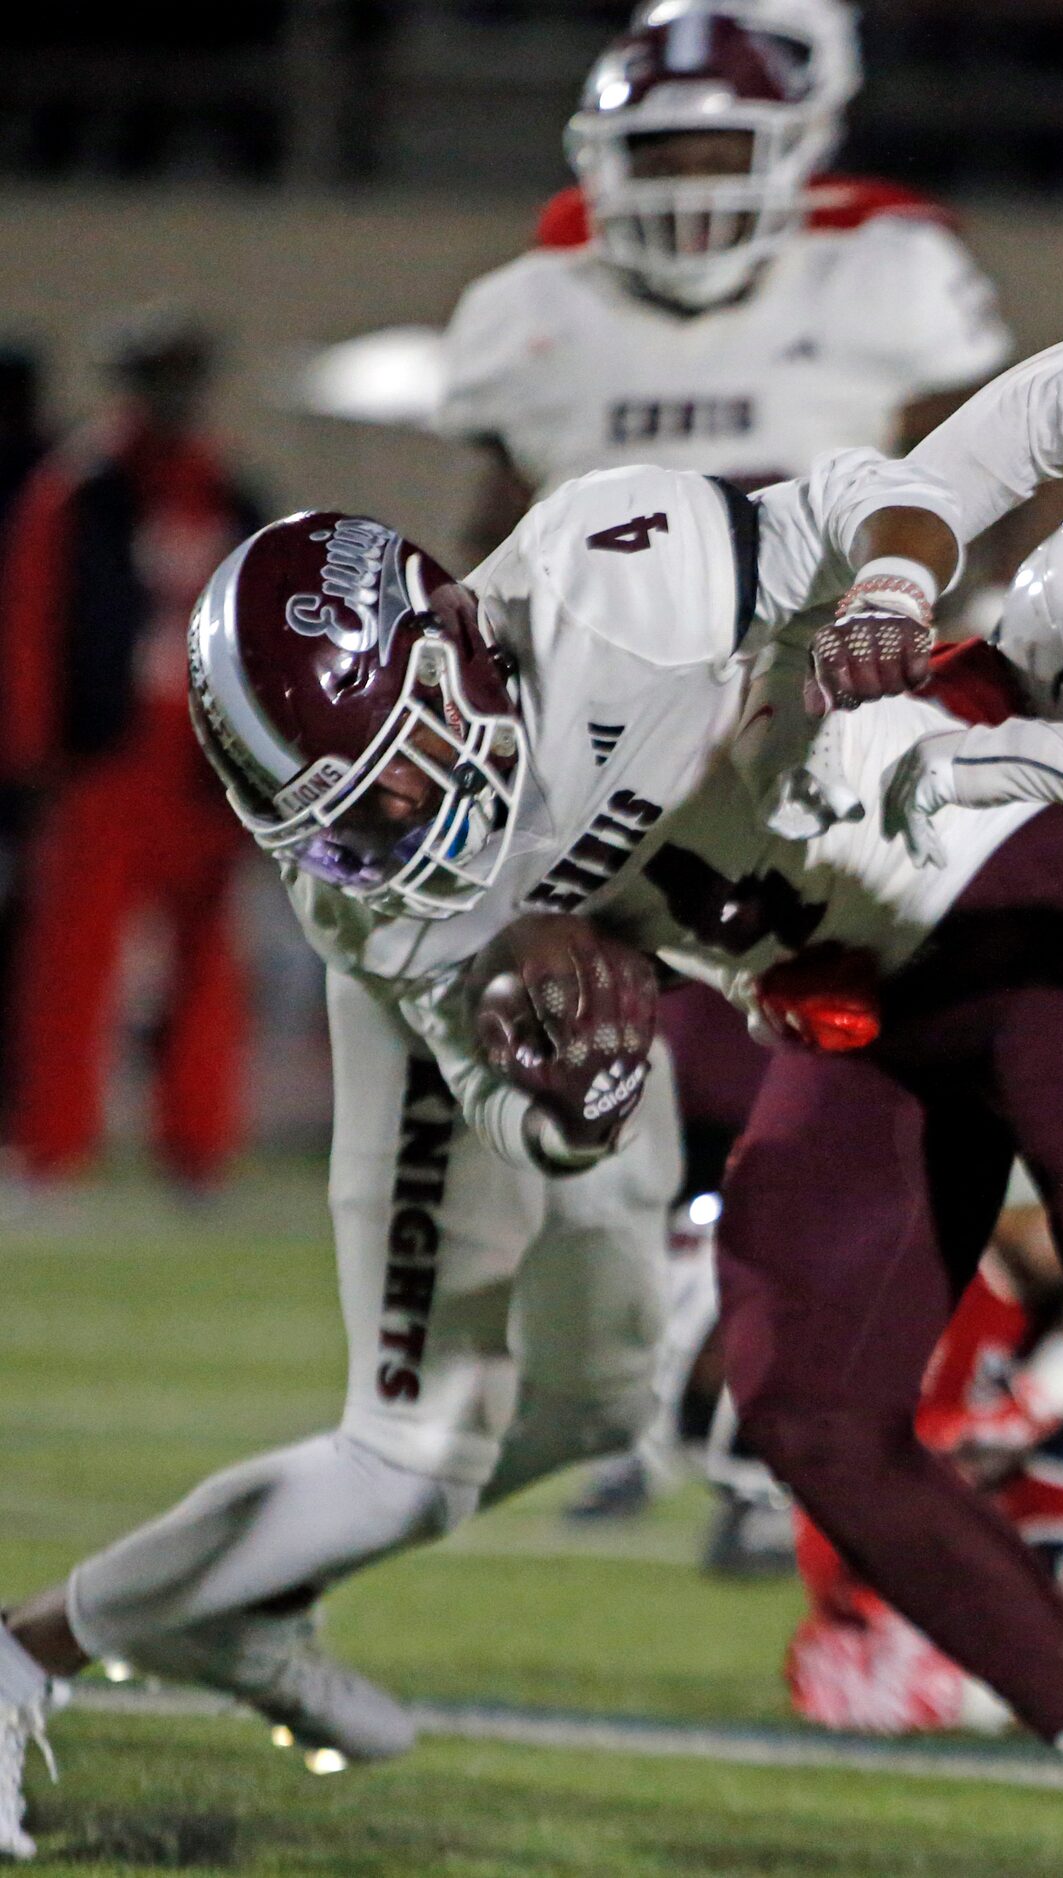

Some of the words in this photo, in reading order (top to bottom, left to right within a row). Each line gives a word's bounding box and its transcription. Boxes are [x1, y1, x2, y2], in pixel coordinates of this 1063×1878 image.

[585, 512, 669, 554] 4
[280, 763, 343, 813] LIONS
[583, 1063, 645, 1120] adidas
